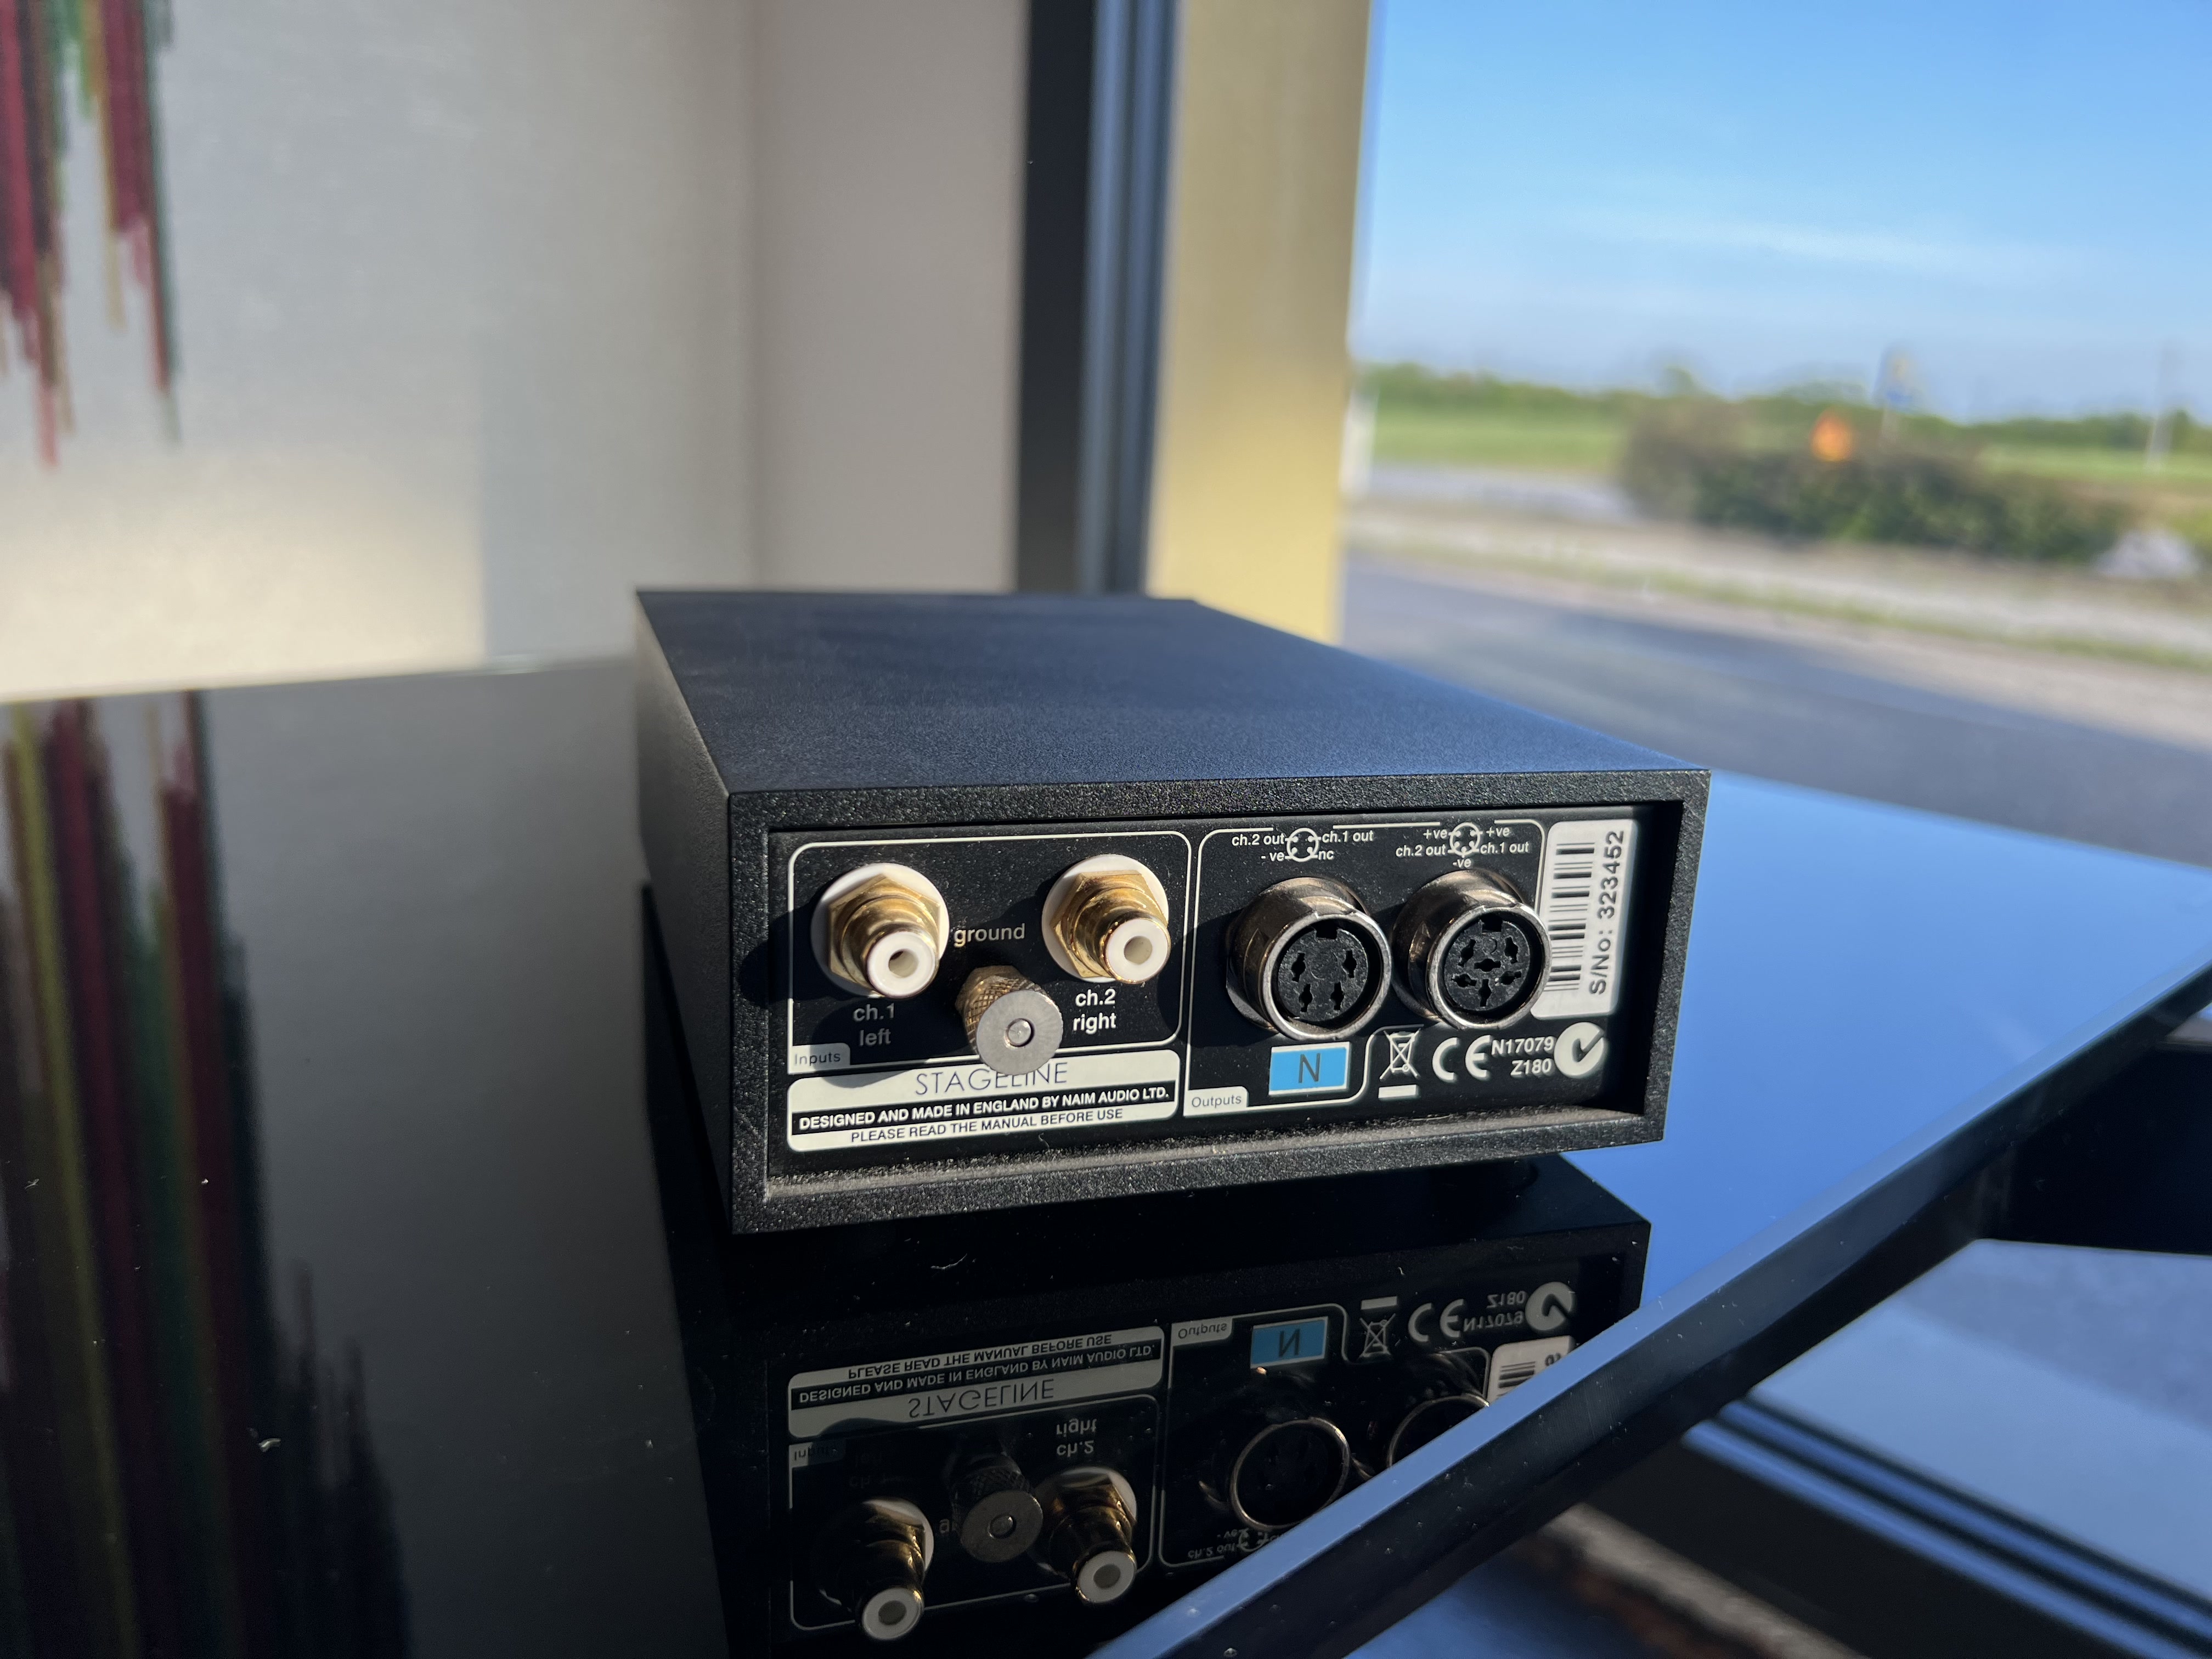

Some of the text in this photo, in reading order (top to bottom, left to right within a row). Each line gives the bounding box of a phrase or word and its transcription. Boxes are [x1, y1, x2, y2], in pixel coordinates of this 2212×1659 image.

[1232, 833, 1285, 846] ch.2 out
[1322, 830, 1374, 843] ch.1 out
[1423, 828, 1448, 840] +ve
[1486, 826, 1510, 837] +ve
[1318, 850, 1335, 860] nc
[1396, 844, 1446, 857] ch.2 out
[1480, 841, 1530, 854] ch.1 out
[1452, 857, 1472, 868] -ve
[1588, 830, 1624, 995] S/No: 323452
[953, 923, 1026, 947] ground
[1075, 989, 1116, 1008] ch.2
[853, 1003, 896, 1023] ch.1
[1073, 1012, 1117, 1034] right
[859, 1029, 891, 1047] left
[1491, 1036, 1555, 1057] N17079
[795, 1052, 841, 1066] Inputs
[1298, 1053, 1321, 1083] N
[1510, 1058, 1554, 1078] Z180
[799, 1087, 1169, 1130] DESIGNED AND MADE IN ENGLAND BY NAIM AUDIO LTD.
[1192, 1094, 1242, 1109] Outputs
[851, 1108, 1123, 1143] PLEASE READ THE MANUAL BEFORE USE
